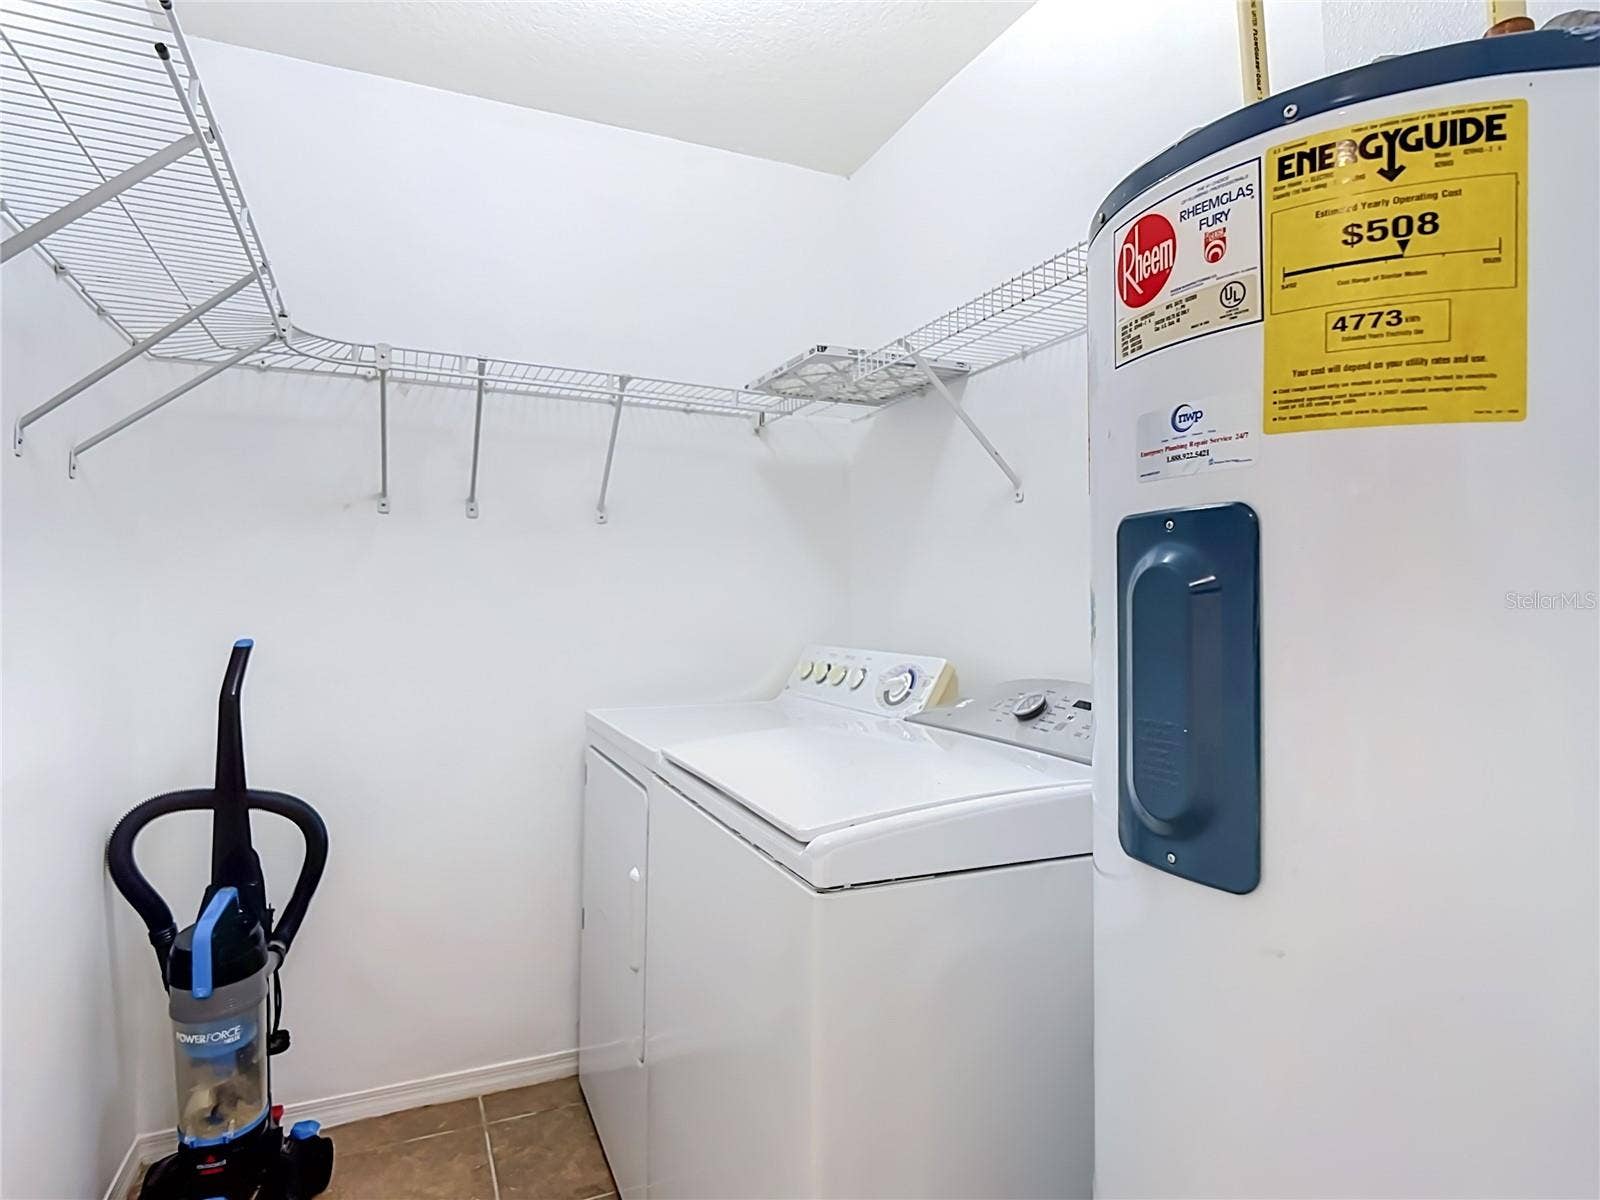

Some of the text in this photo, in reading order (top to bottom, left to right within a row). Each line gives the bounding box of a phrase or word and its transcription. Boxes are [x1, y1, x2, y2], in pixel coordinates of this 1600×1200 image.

[1278, 113, 1507, 182] ENERGYGUIDE
[1180, 184, 1254, 222] RHEEMGLAS
[1315, 188, 1462, 218] Estimed Yearly Operating Cost
[1200, 208, 1231, 231] FURY
[1341, 212, 1440, 248] $508
[1122, 224, 1174, 301] Rheem
[1332, 310, 1403, 332] 4773
[1292, 370, 1308, 378] Your
[1311, 367, 1325, 376] cost
[1328, 364, 1341, 373] will
[1344, 362, 1371, 372] depend
[1386, 360, 1402, 369] your
[1406, 358, 1428, 367] utility
[1453, 354, 1468, 363] and
[1178, 410, 1204, 424] nwp
[176, 1025, 240, 1044] POWERFORCE
